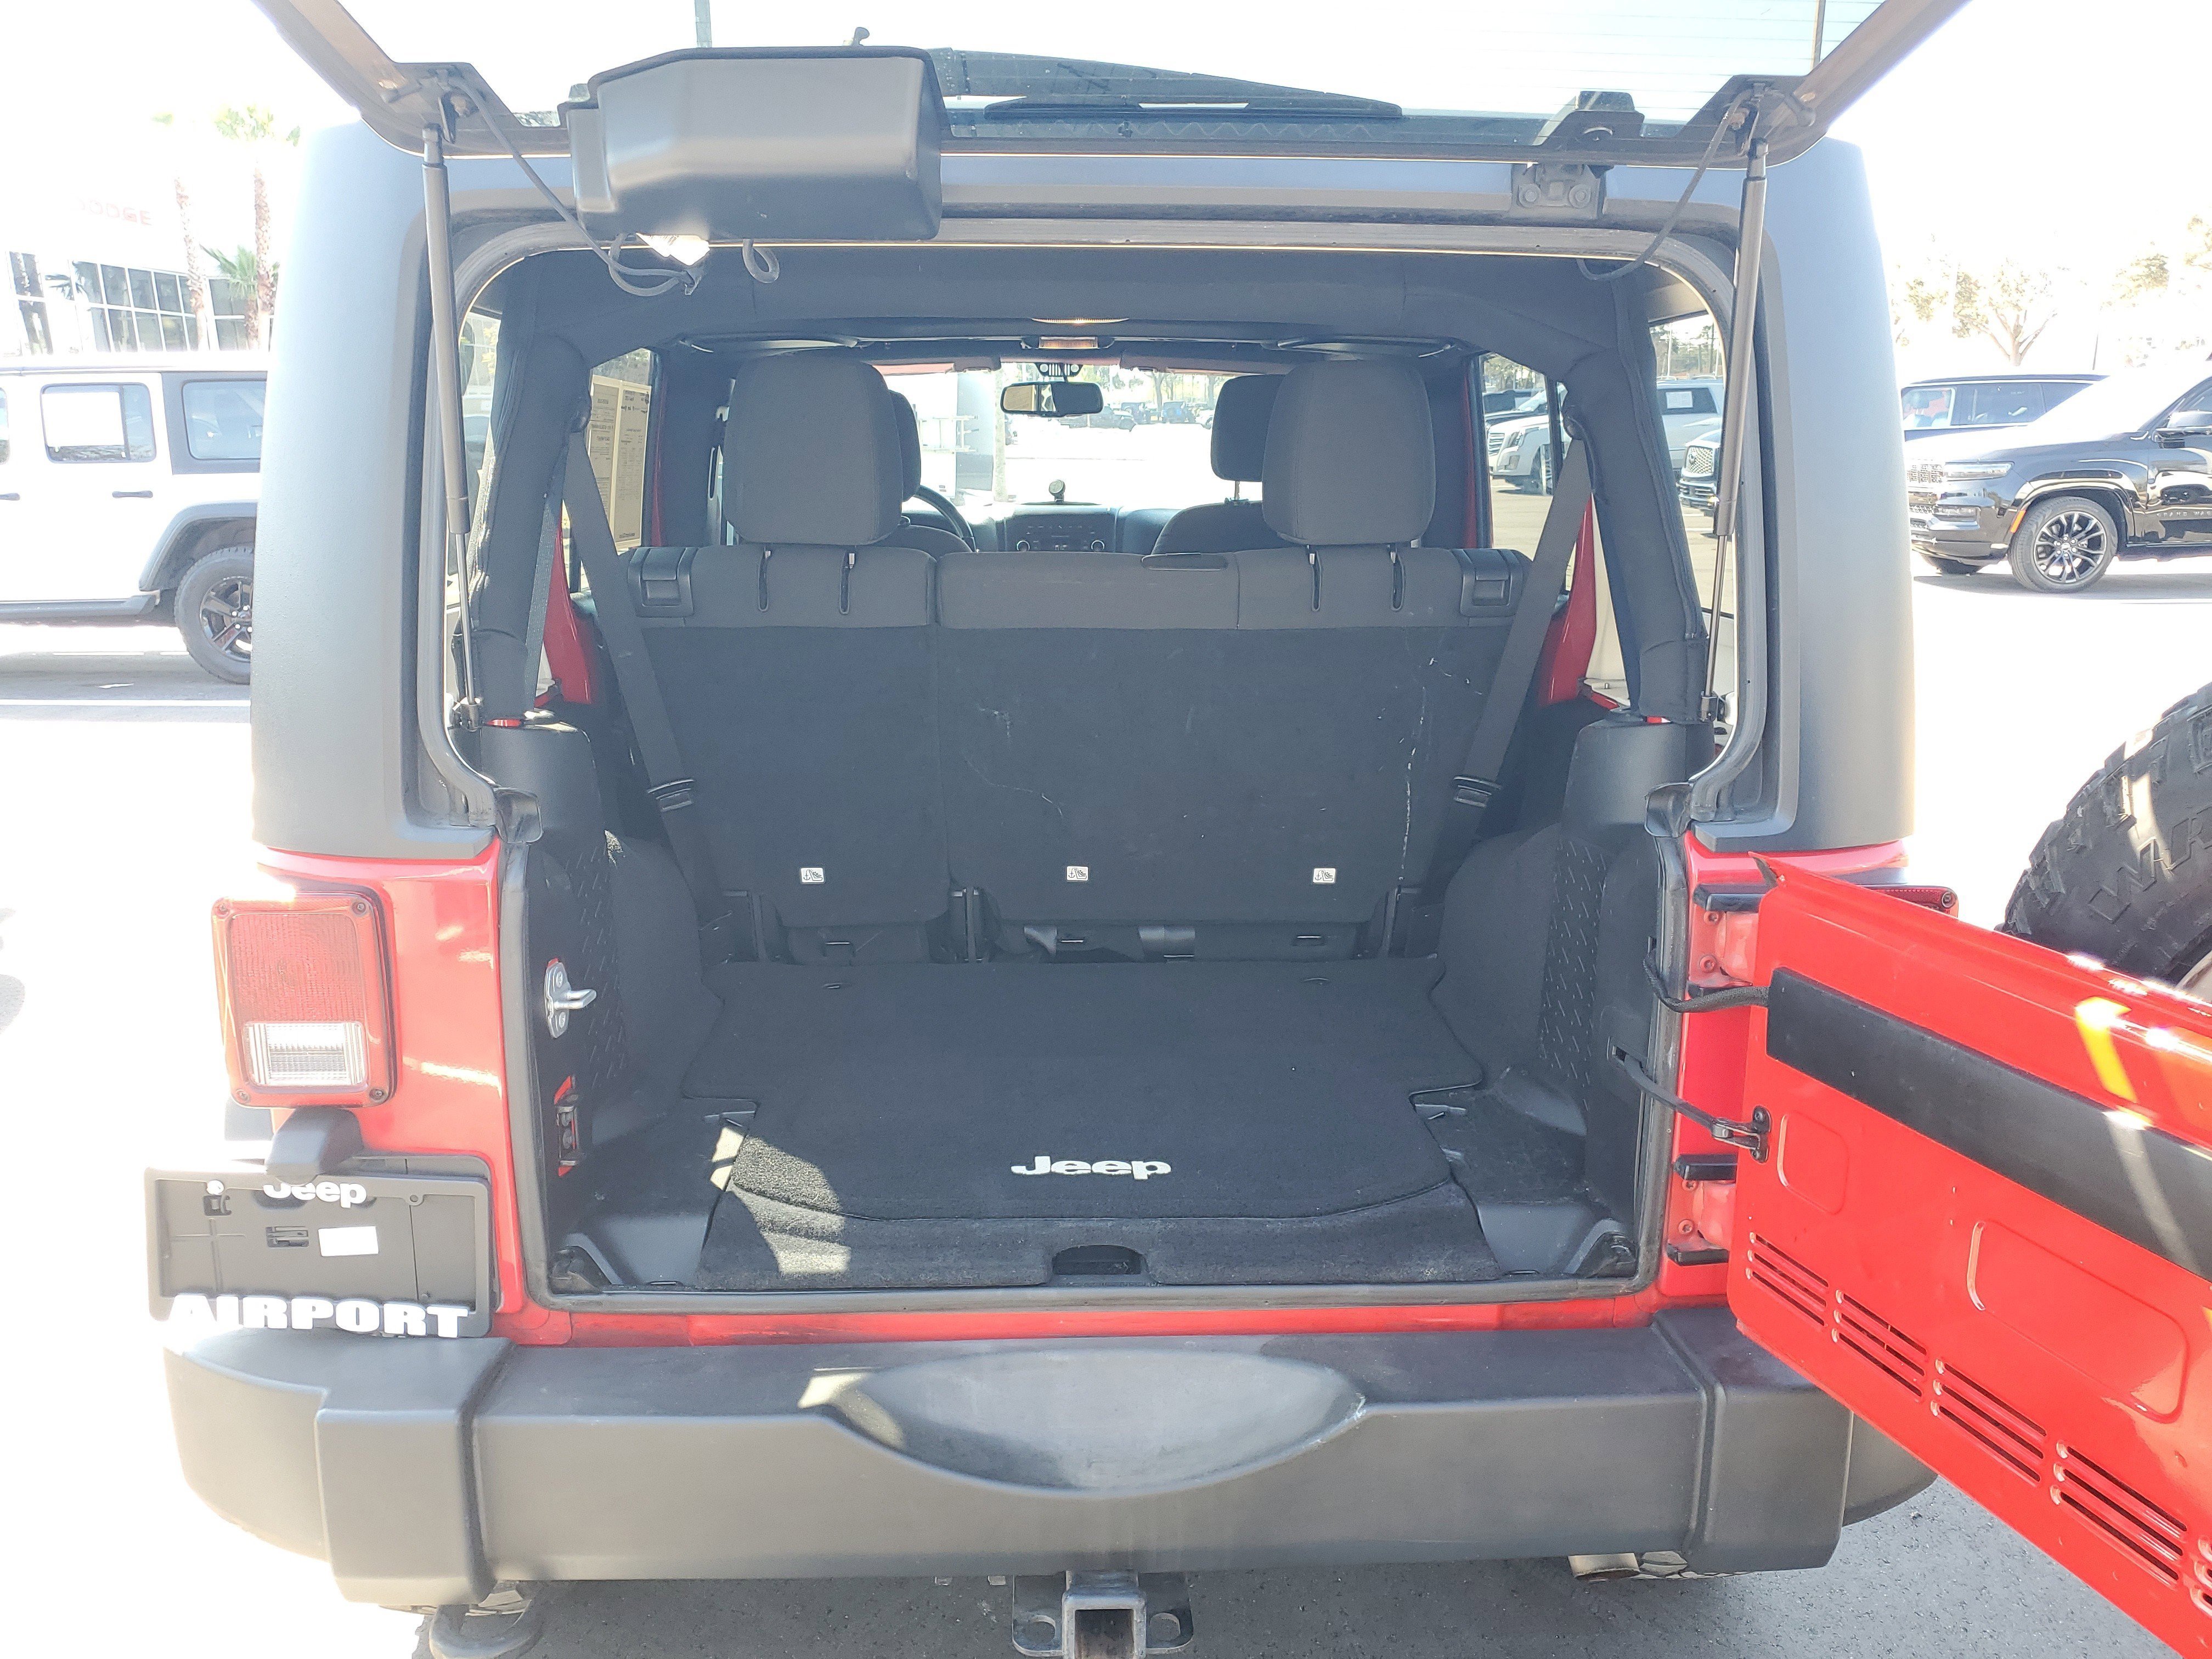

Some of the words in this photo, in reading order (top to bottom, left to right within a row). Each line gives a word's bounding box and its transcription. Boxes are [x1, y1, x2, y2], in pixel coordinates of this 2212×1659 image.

[1011, 1155, 1171, 1180] Jeep
[262, 1181, 366, 1208] Jeep
[168, 1293, 469, 1338] AIRPORT
